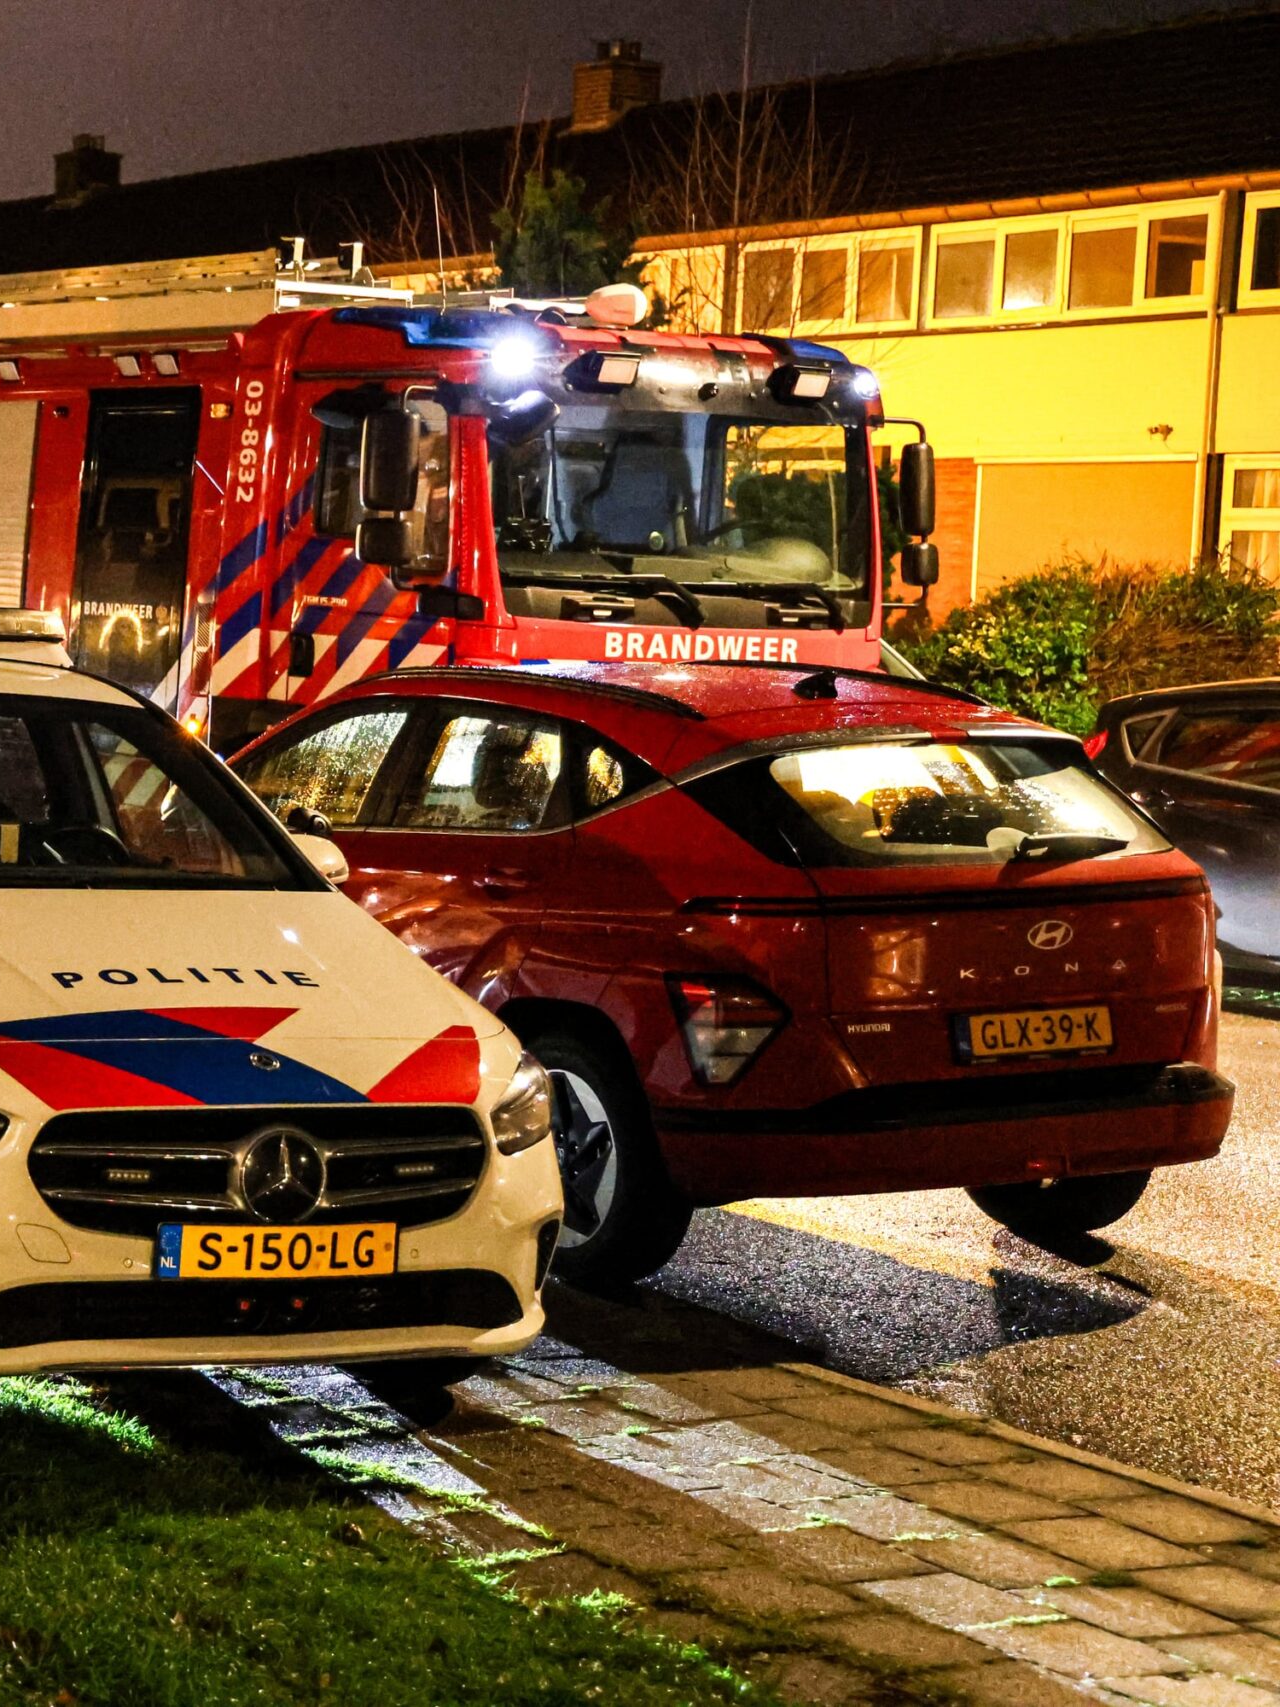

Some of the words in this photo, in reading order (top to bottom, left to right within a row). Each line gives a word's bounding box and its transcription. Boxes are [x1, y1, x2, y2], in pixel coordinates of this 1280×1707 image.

[236, 380, 264, 503] 03-8632
[83, 601, 153, 619] BRANDWEER
[604, 632, 798, 663] BRANDWEER
[51, 968, 320, 989] POLITIE
[847, 1023, 891, 1033] HYUNDAI
[981, 1012, 1102, 1050] GLX-39-K
[160, 1256, 177, 1269] NL
[197, 1230, 375, 1271] S-150-LG
